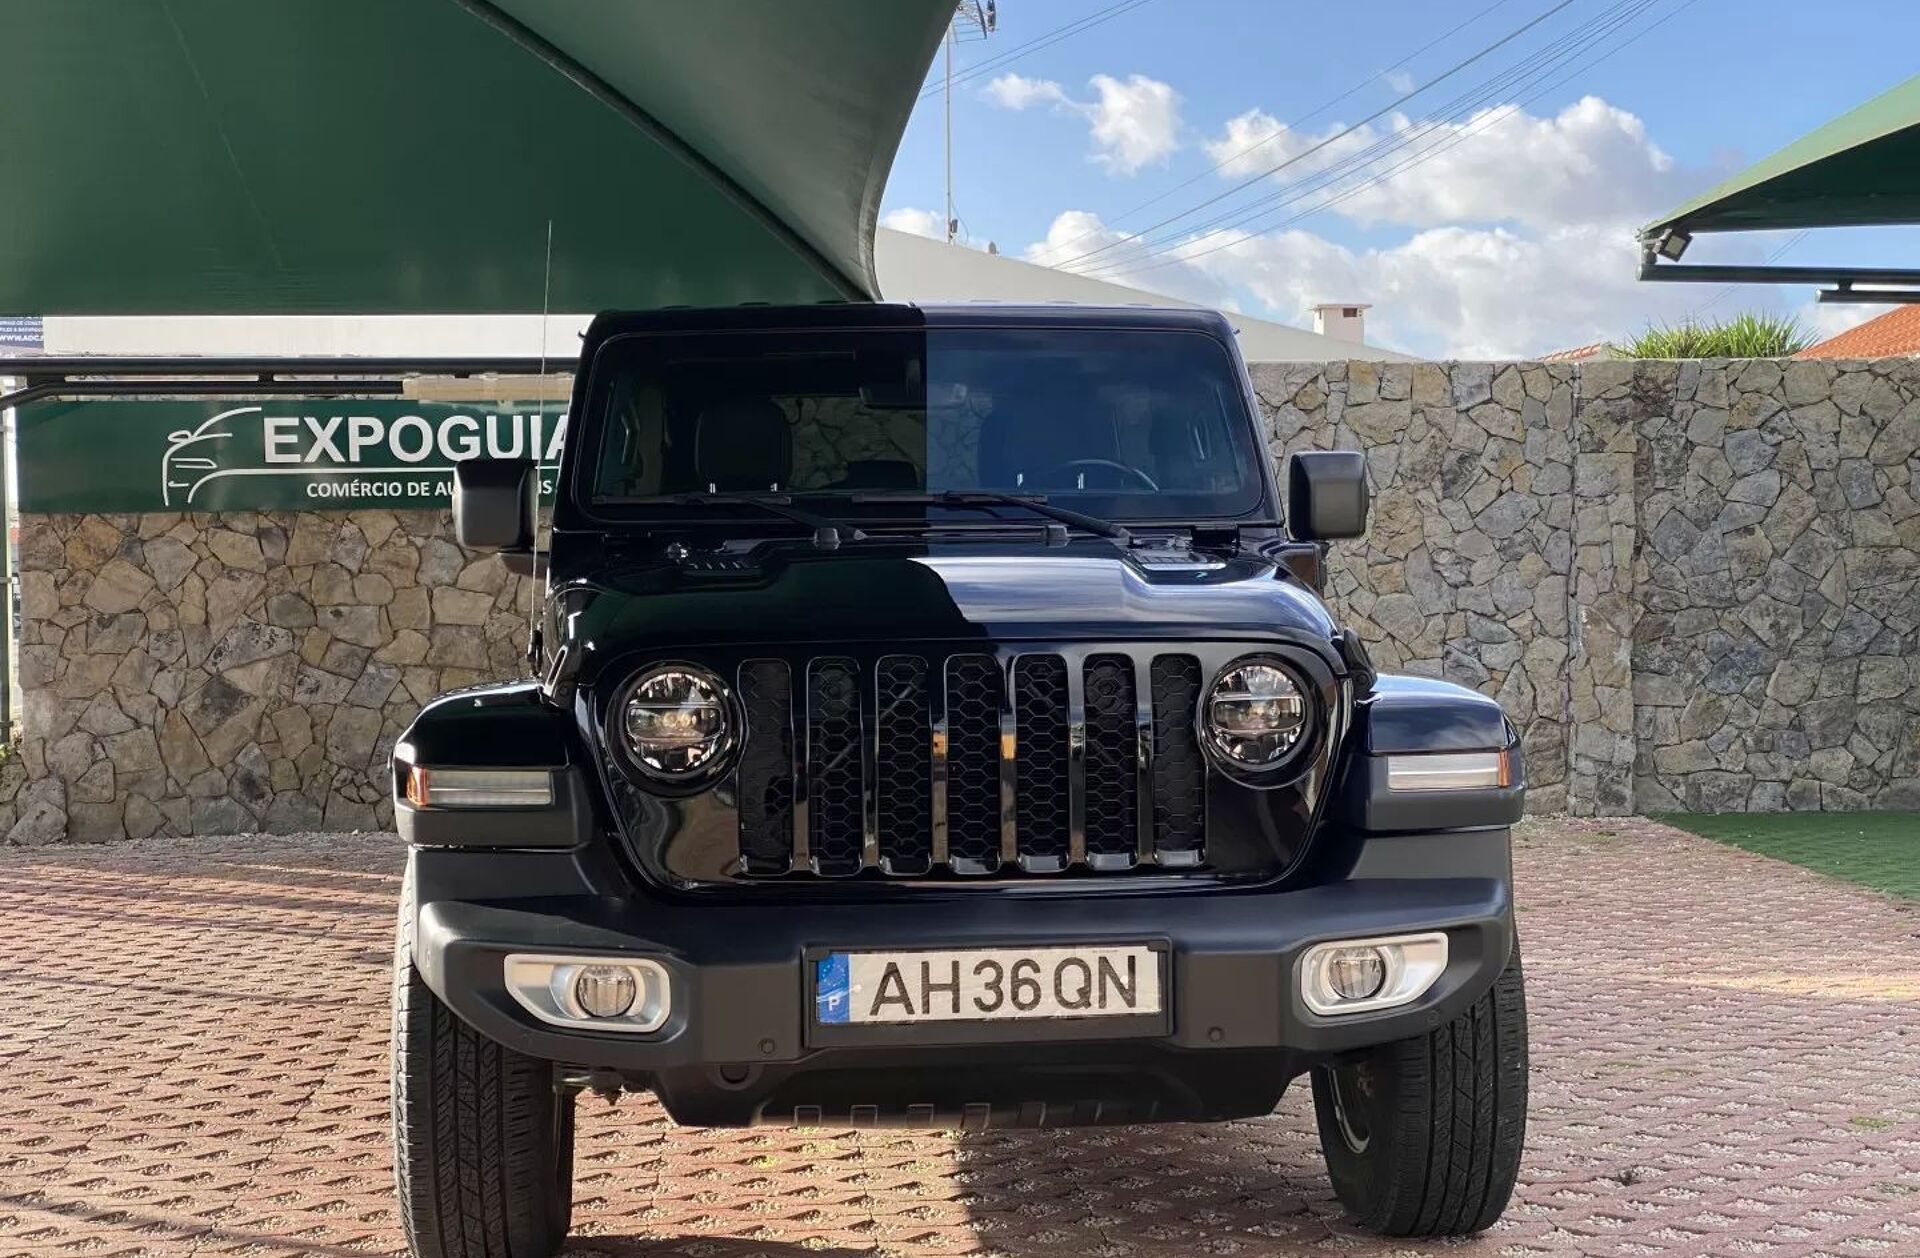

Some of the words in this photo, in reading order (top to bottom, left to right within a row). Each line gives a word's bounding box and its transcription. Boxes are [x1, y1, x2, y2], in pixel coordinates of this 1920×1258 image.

[306, 479, 401, 498] COMÉRCIO
[407, 481, 430, 497] DE
[827, 996, 841, 1012] P
